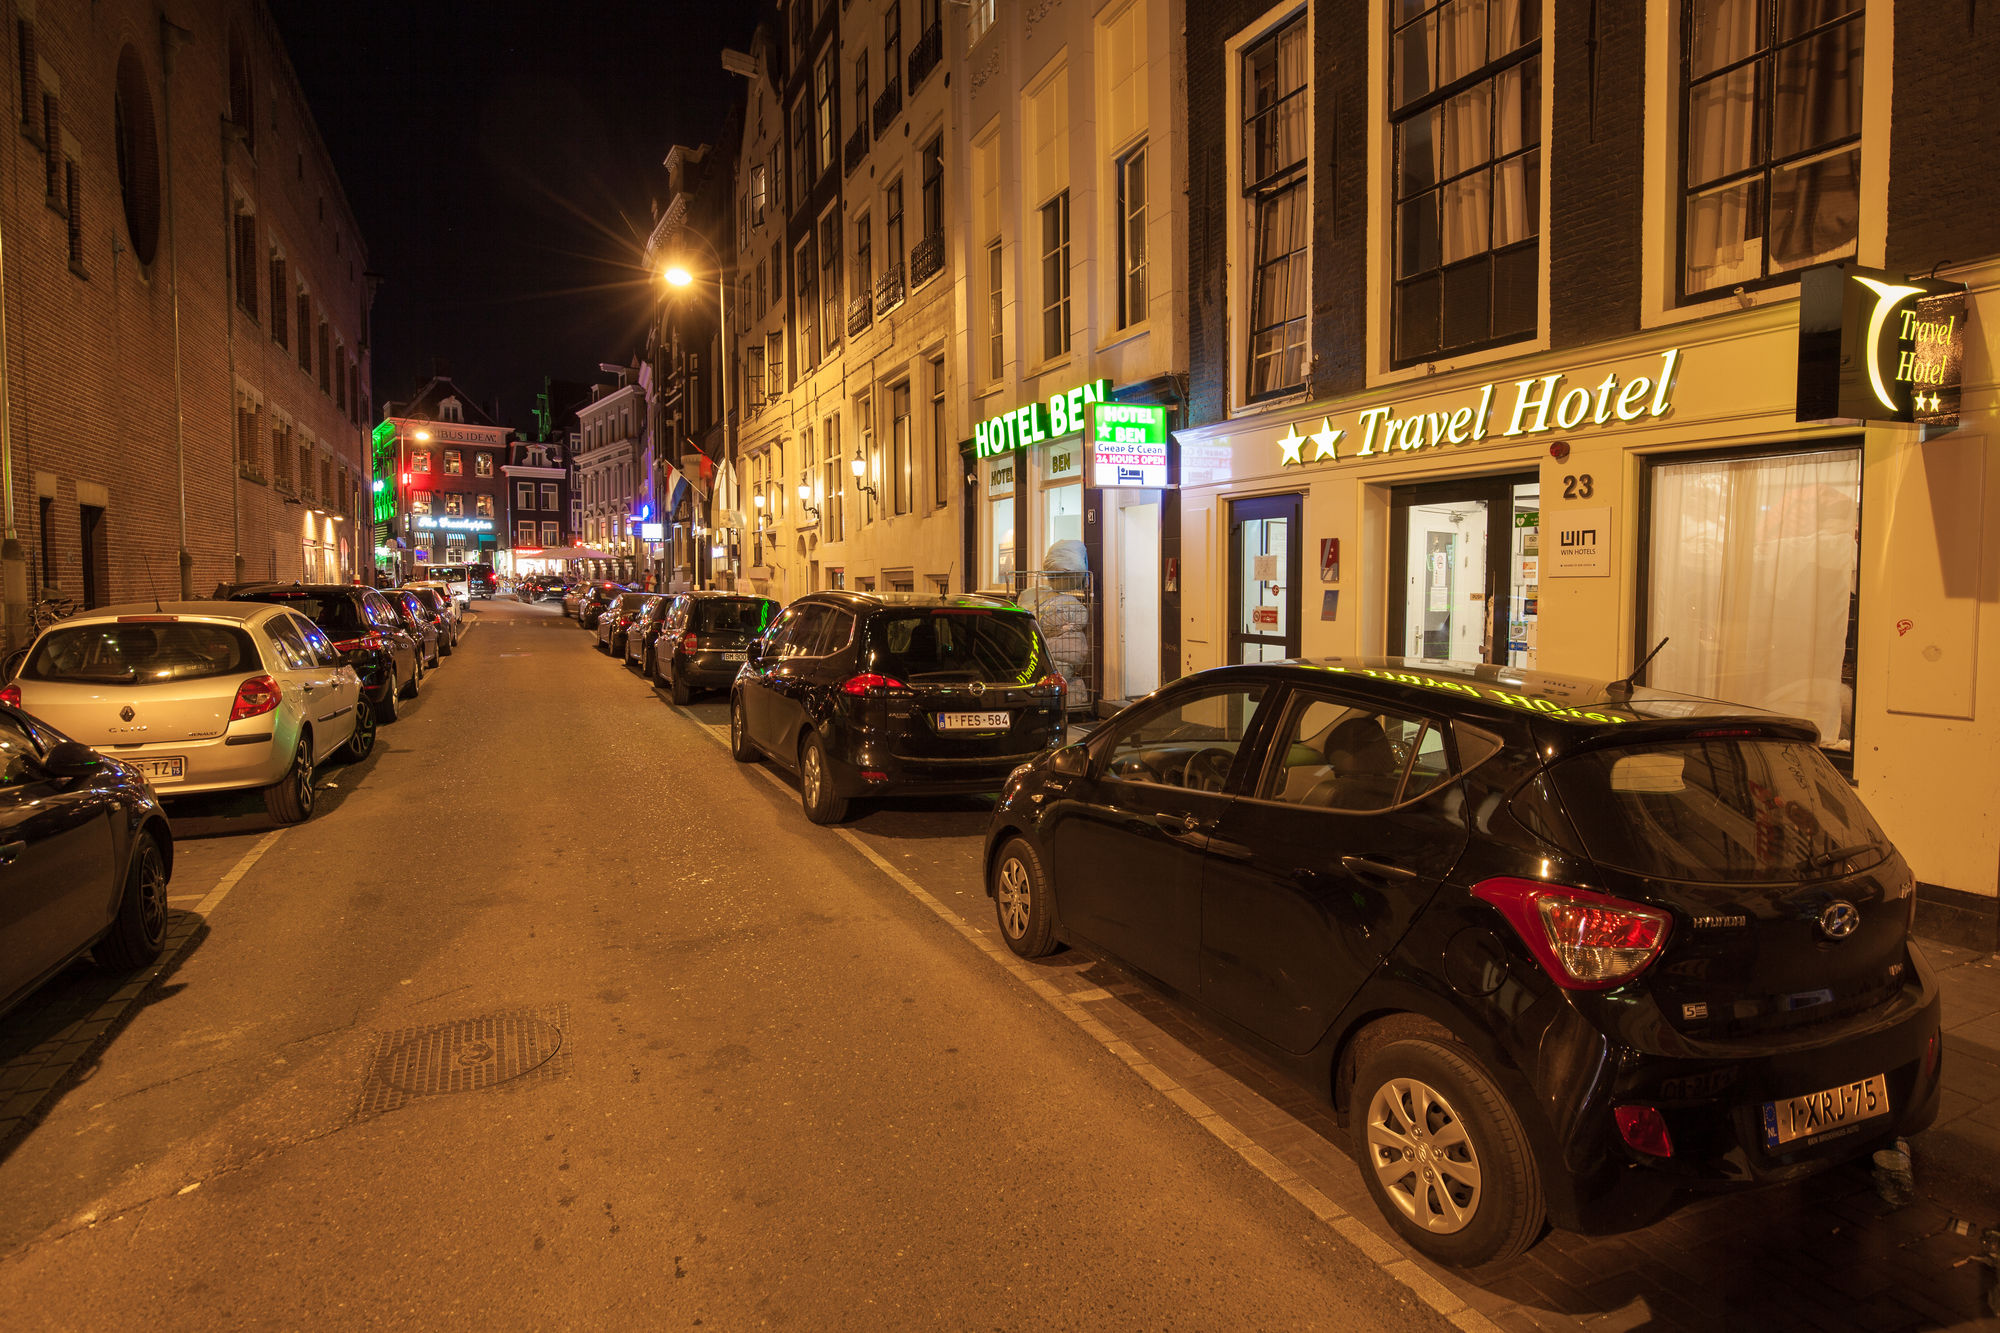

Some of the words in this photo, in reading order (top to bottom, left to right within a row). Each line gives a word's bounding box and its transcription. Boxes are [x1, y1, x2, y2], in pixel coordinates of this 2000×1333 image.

[1899, 309, 1955, 346] Travel
[1896, 351, 1947, 385] Hotel
[1356, 383, 1495, 457] Travel
[1503, 348, 1681, 437] Hotel
[975, 402, 1046, 459] HOTEL
[1049, 379, 1105, 438] BEN
[1104, 405, 1155, 424] HOTEL
[1115, 426, 1146, 443] BEN
[1127, 444, 1135, 453] &
[1052, 452, 1071, 474] BEN
[1096, 454, 1109, 465] 24
[1109, 454, 1140, 465] HOURS
[1140, 455, 1165, 466] OPEN
[991, 467, 1014, 486] HOTEL
[1563, 473, 1594, 499] 23
[1574, 548, 1596, 556] HOTELS
[109, 725, 148, 733] CLIO
[1692, 915, 1747, 928] HYUNDAI
[1767, 1126, 1778, 1138] NL
[1786, 1080, 1877, 1137] 1-XRJ-75
